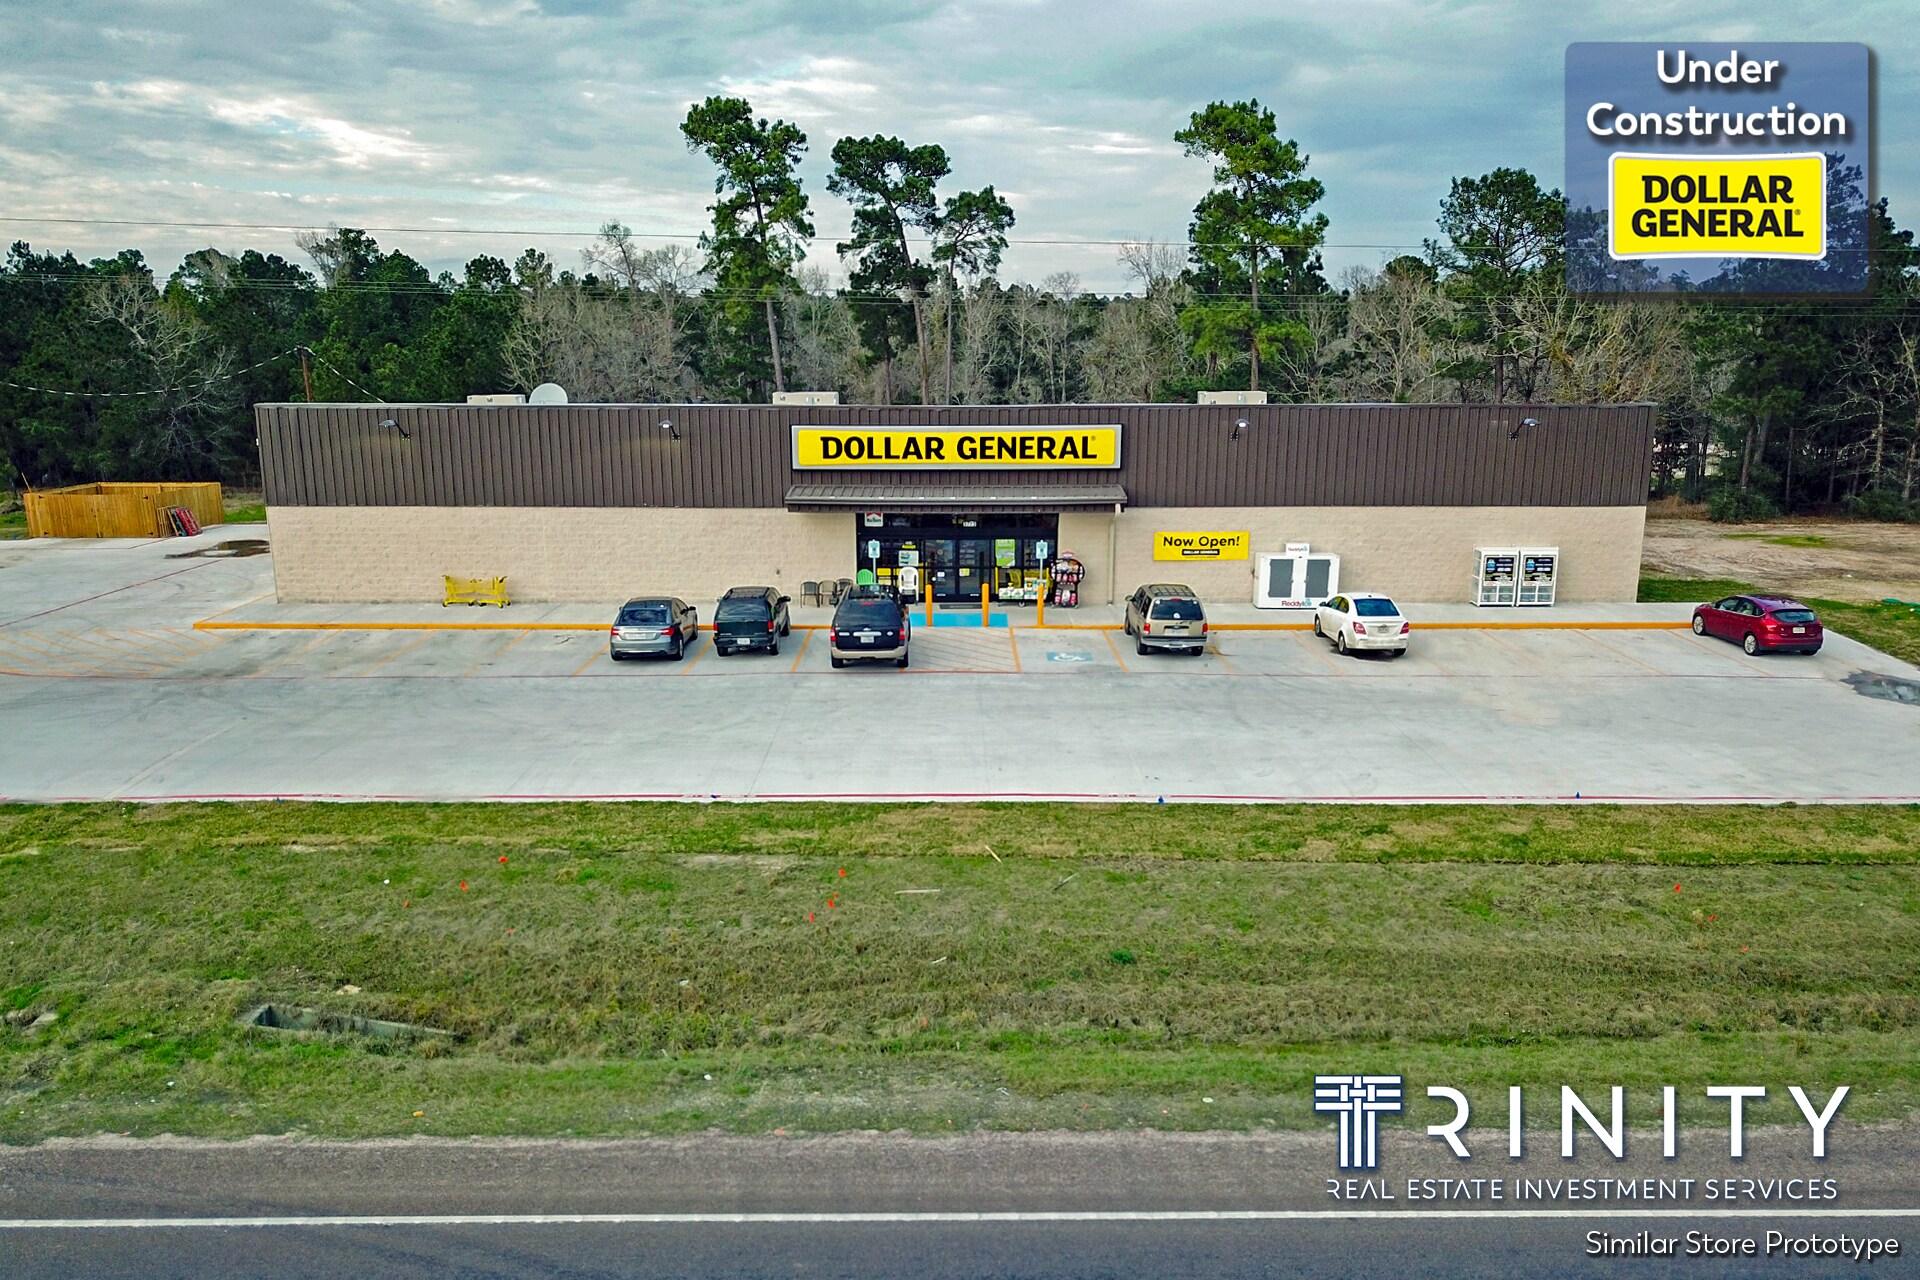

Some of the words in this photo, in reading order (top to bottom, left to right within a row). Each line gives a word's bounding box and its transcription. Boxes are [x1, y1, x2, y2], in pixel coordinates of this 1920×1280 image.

[820, 436, 946, 460] DOLLAR
[956, 436, 1098, 460] GENERAL
[1163, 536, 1194, 547] Now
[1198, 535, 1240, 549] Open!
